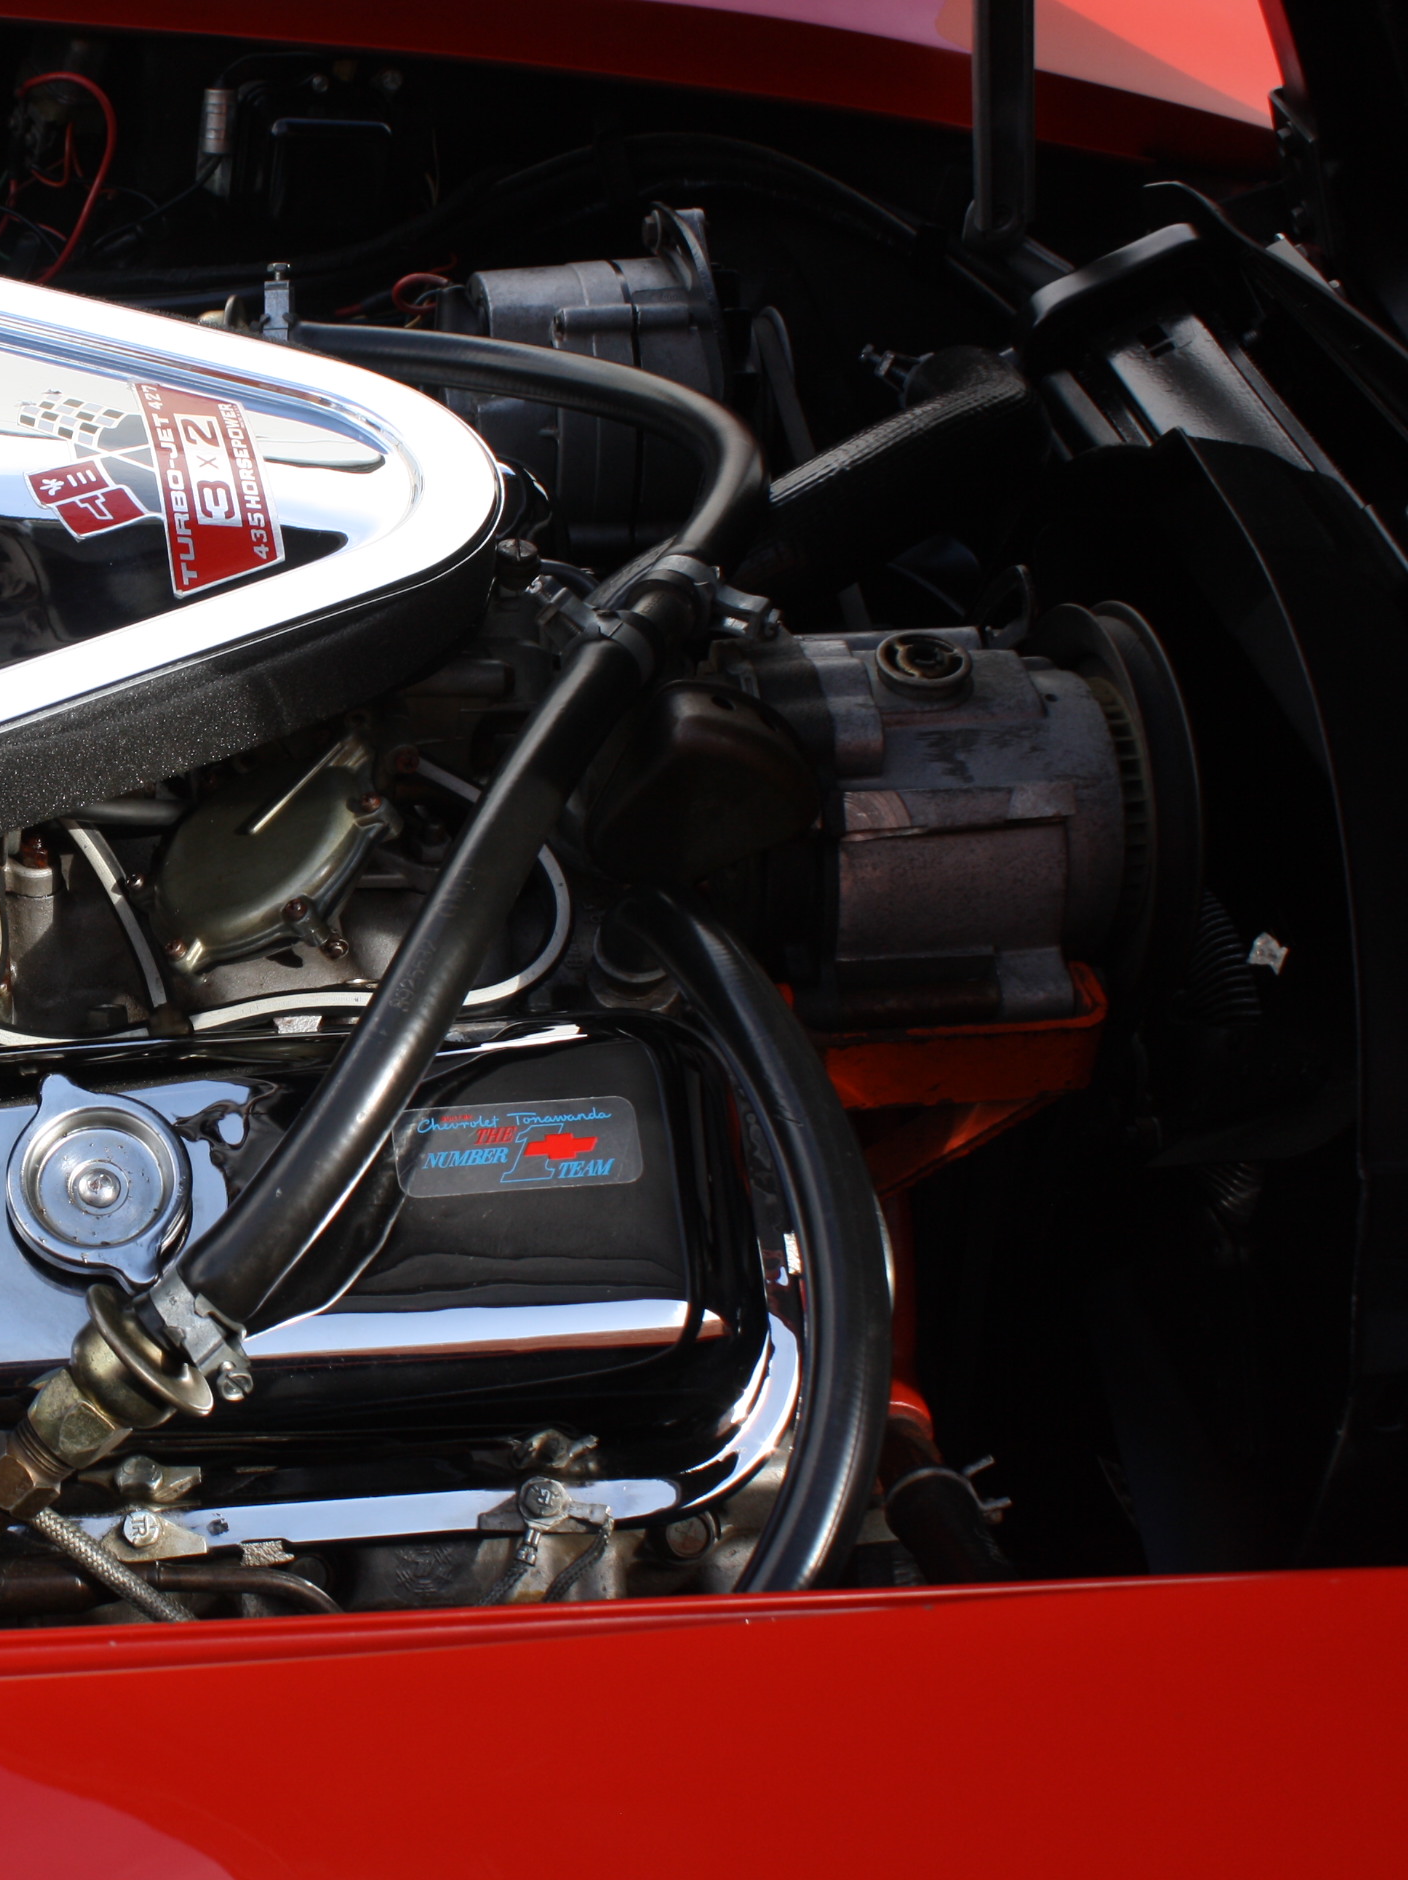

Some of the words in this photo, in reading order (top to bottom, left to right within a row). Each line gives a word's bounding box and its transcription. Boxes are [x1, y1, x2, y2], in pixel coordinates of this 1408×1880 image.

[144, 384, 162, 411] 427
[185, 417, 221, 448] 2
[155, 413, 198, 586] TURBO-JET
[196, 480, 235, 520] 3
[417, 1115, 500, 1133] Chevrolet
[506, 1107, 613, 1126] Tonawanda
[474, 1126, 517, 1145] THE
[423, 1147, 509, 1169] NUMBER
[558, 1158, 615, 1179] TEAM
